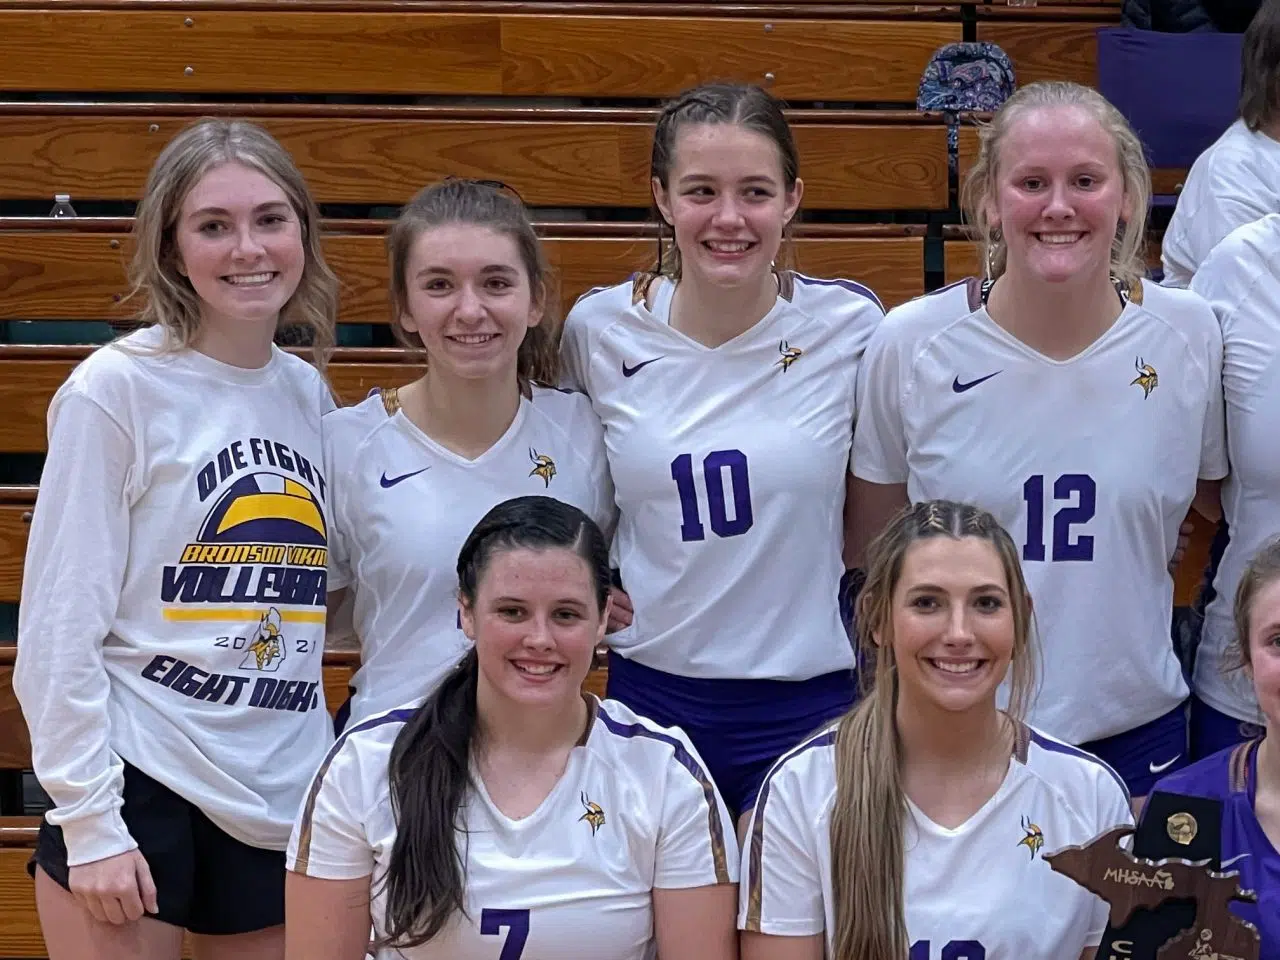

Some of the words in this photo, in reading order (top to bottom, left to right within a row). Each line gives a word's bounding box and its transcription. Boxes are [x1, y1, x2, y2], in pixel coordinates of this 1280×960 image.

[197, 440, 248, 502] ONE
[249, 438, 326, 504] FIGHT
[671, 449, 753, 542] 10
[1023, 474, 1096, 562] 12
[179, 544, 287, 565] BRONSON
[214, 636, 246, 649] 20
[141, 655, 250, 705] EIGHT
